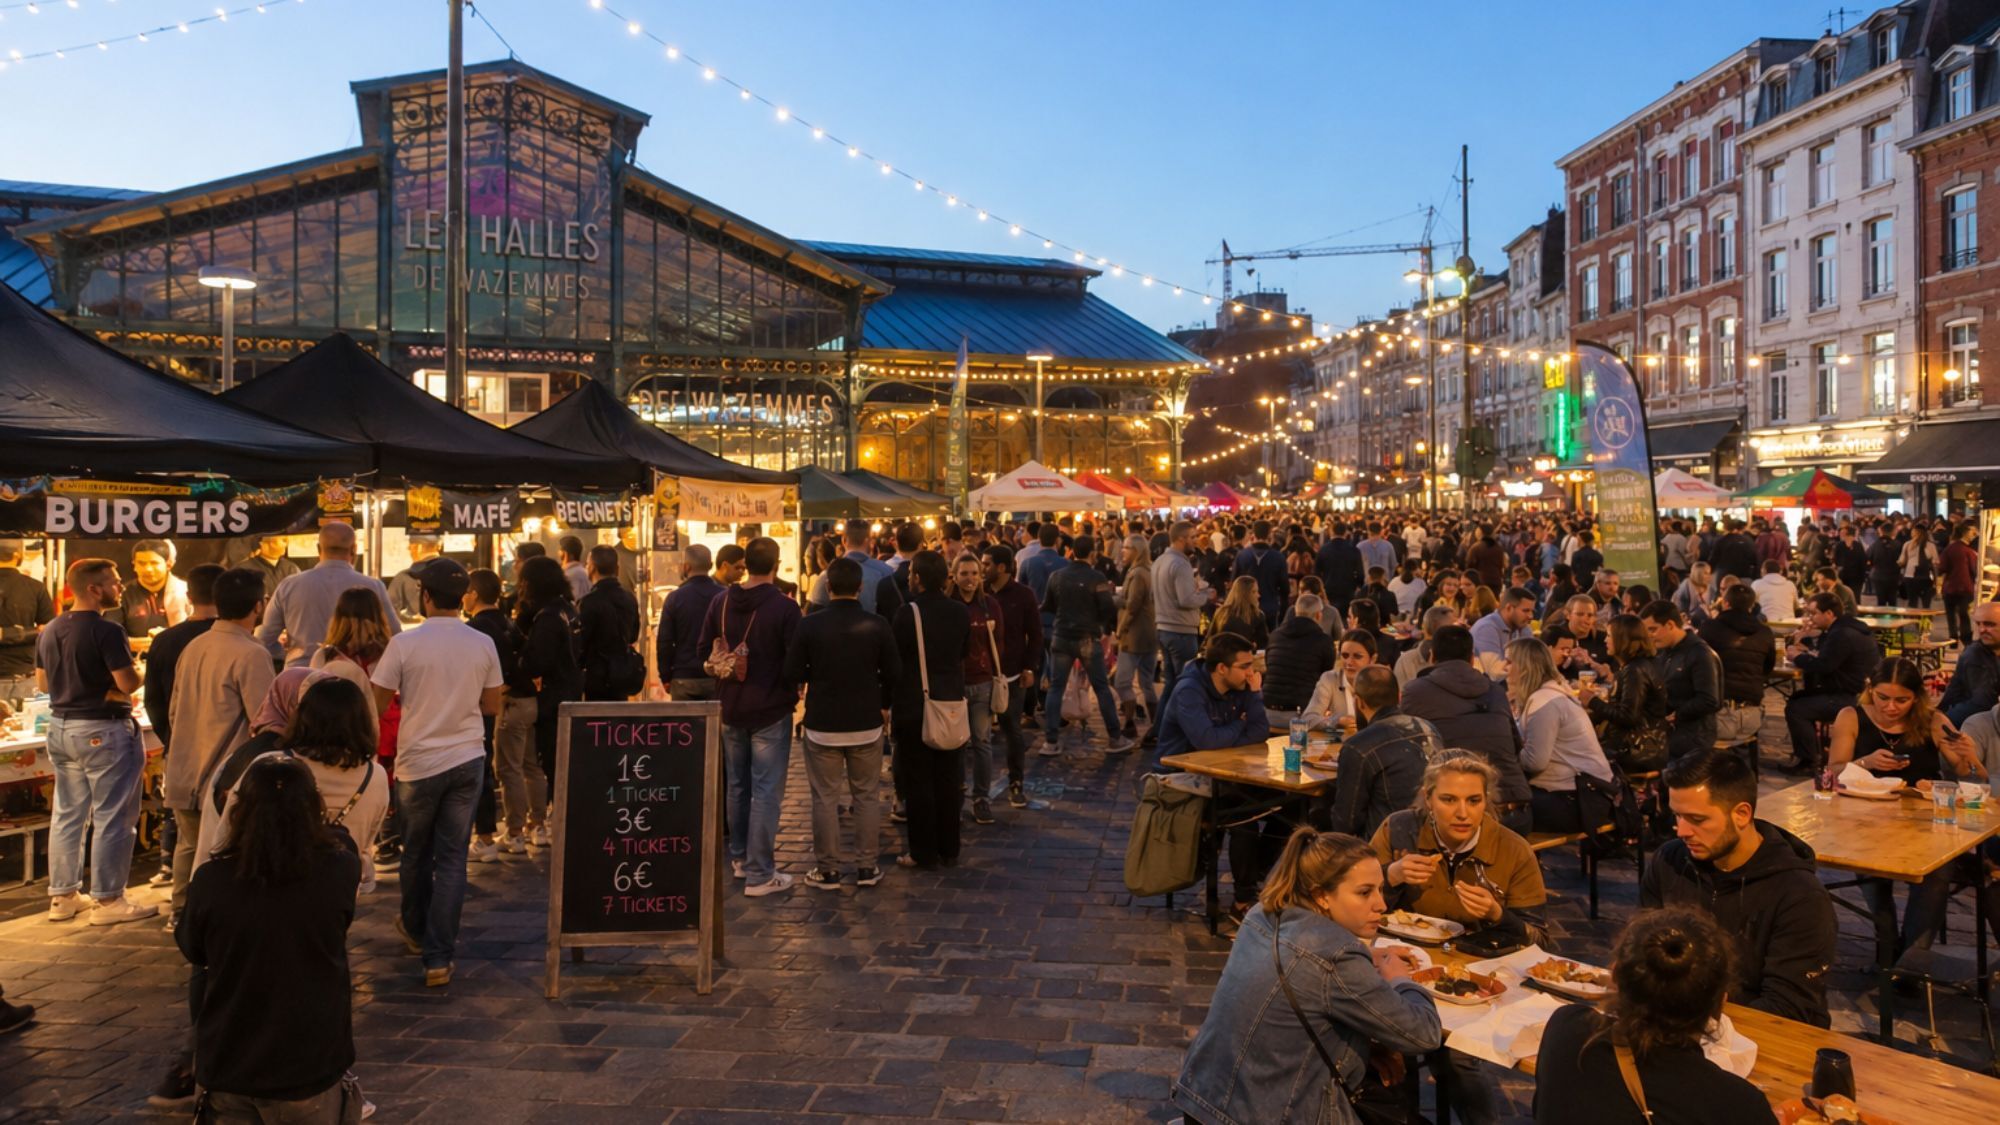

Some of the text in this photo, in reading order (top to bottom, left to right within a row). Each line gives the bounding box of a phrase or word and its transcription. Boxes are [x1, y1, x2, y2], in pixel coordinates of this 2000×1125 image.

[405, 208, 600, 262] LE HALLES
[414, 264, 442, 292] DE
[45, 496, 250, 534] BURGERS
[453, 496, 511, 529] MAFÉ
[555, 500, 632, 523] BEIGNETS
[617, 753, 652, 782] 1€
[606, 786, 681, 804] 1 TICKET
[615, 806, 652, 834] 3€
[602, 836, 692, 857] 4 TICKETS
[613, 861, 653, 892] 6€
[602, 896, 688, 915] 7 TICKETS
